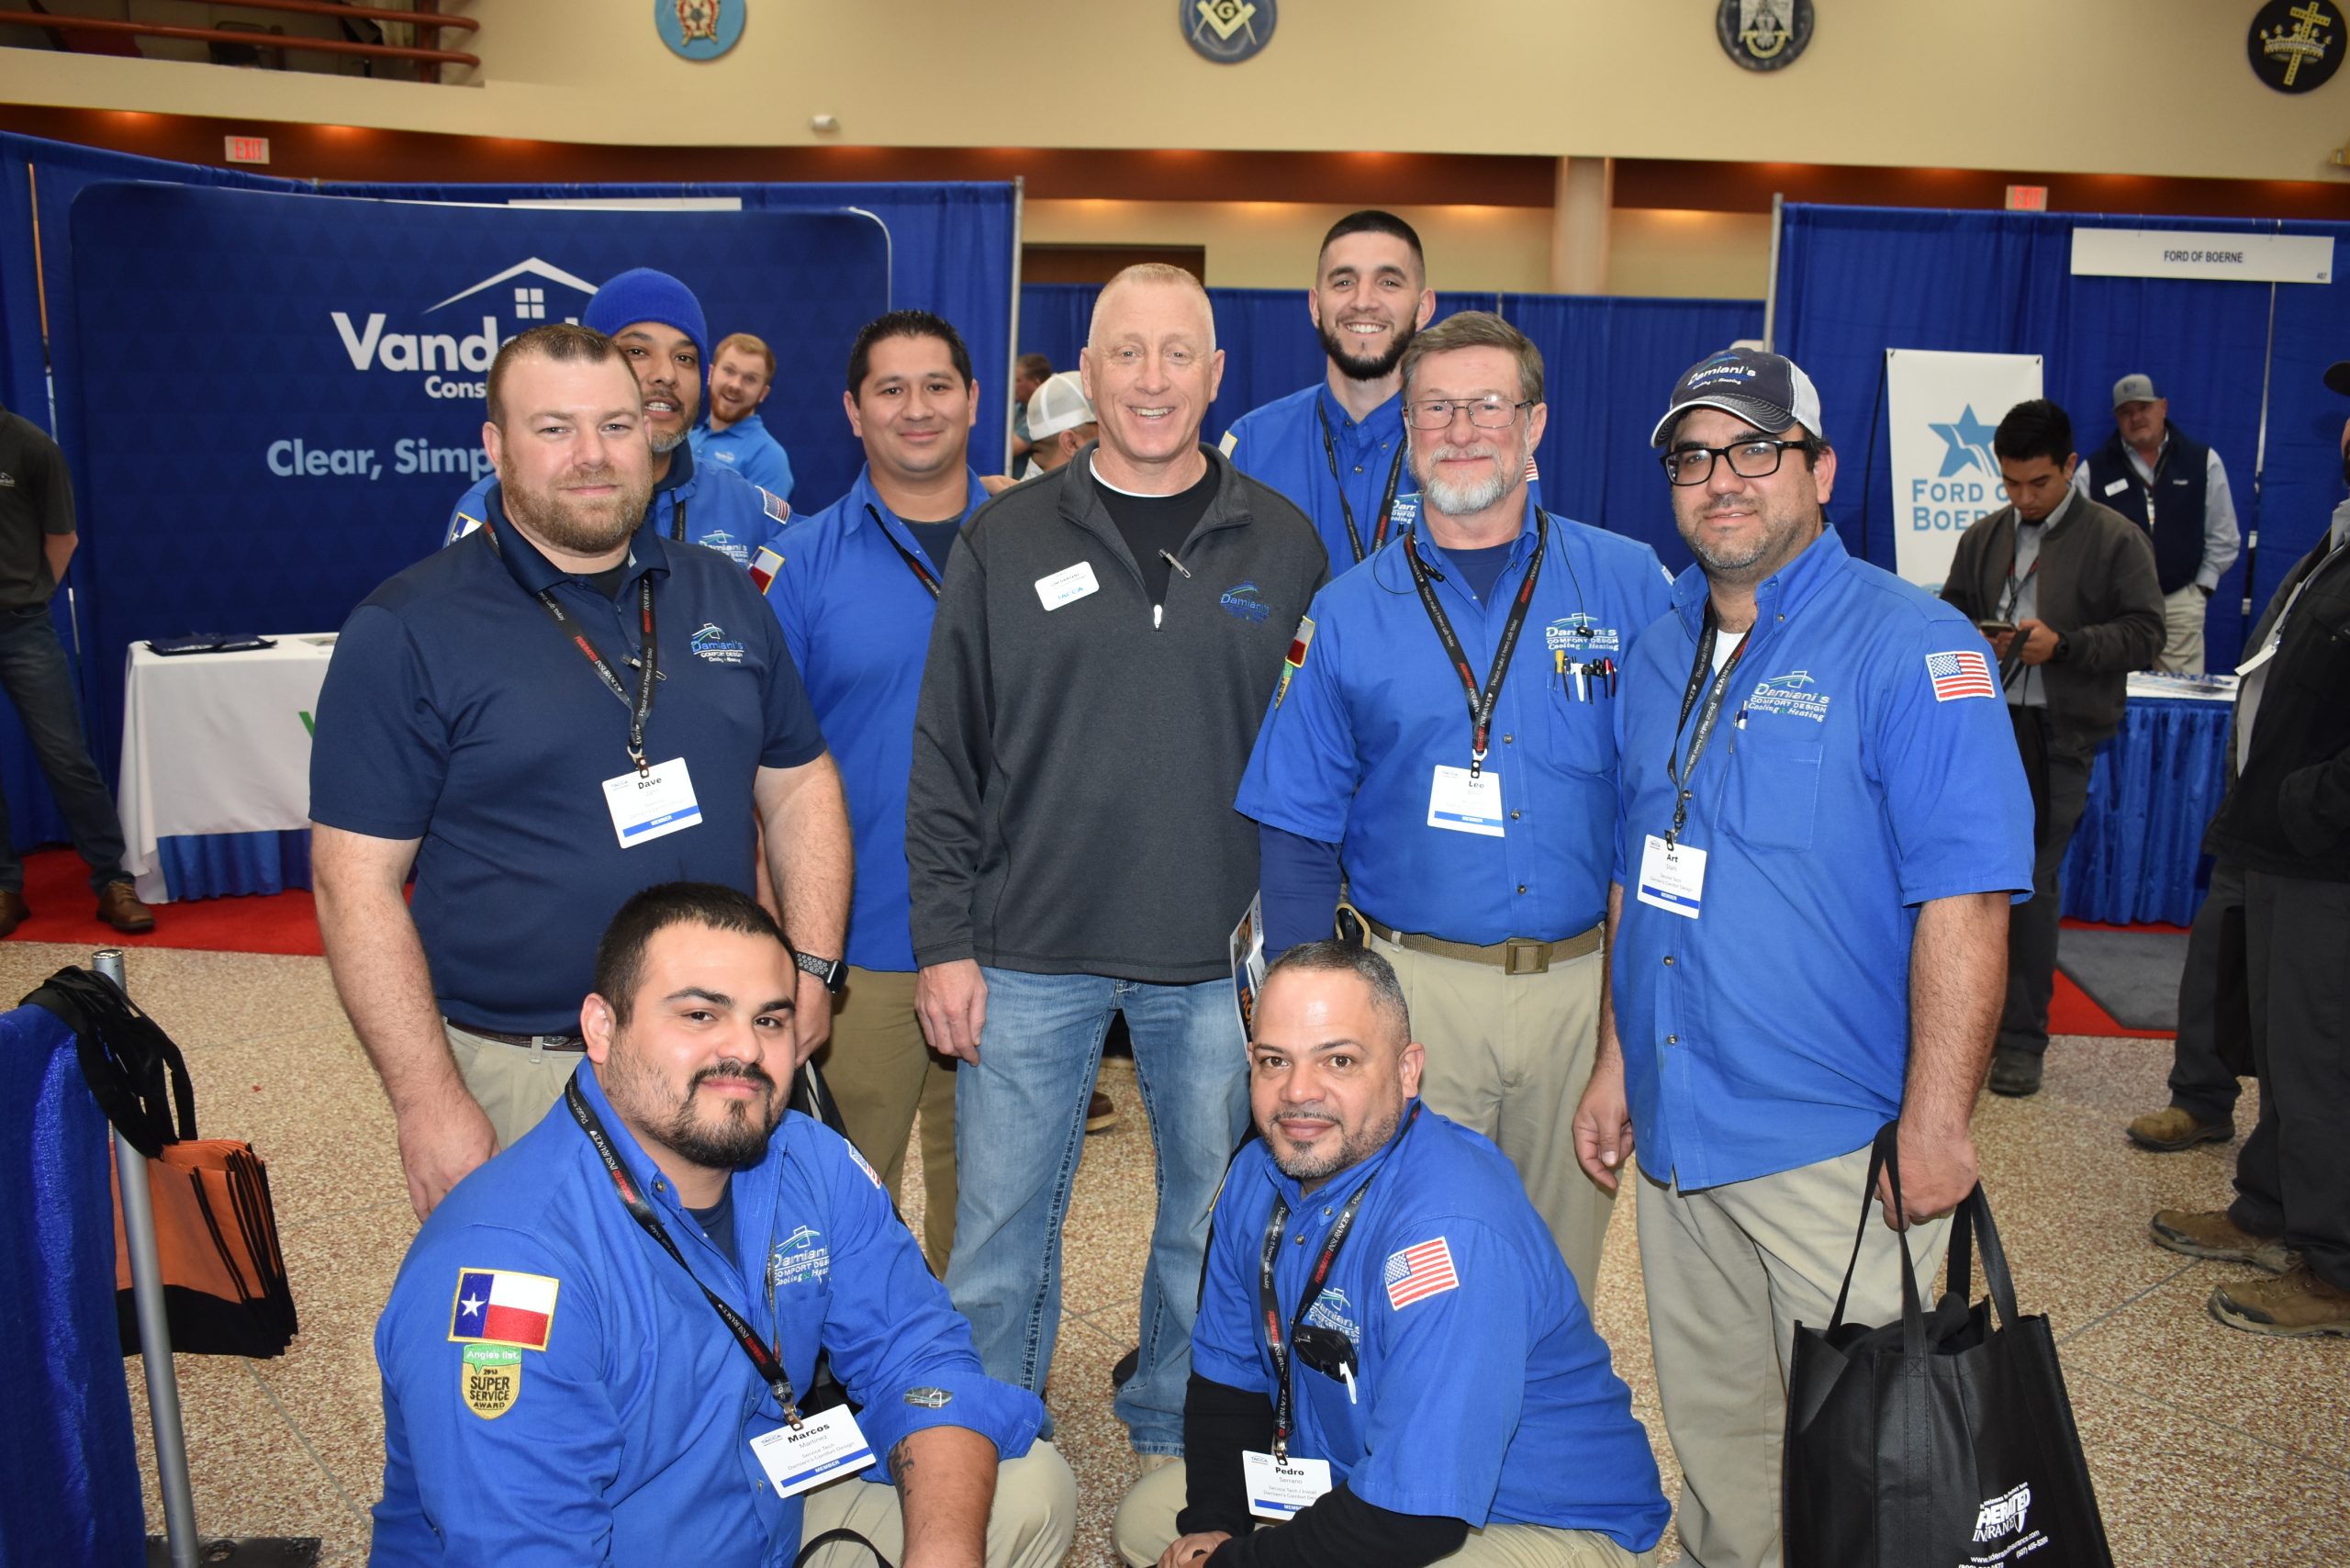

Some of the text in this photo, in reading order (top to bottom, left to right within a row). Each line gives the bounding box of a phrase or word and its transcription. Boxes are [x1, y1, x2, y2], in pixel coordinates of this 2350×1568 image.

[234, 137, 263, 162] EXIT
[2013, 185, 2042, 208] EXIT
[2164, 250, 2244, 263] FORD OF BOERNE
[330, 311, 516, 373] Vand
[266, 438, 382, 481] Clear,
[1911, 478, 1984, 503] FORD
[1548, 643, 1581, 651] Cooling
[1754, 682, 1830, 704] Damiani's
[1706, 701, 1718, 720] Please
[1748, 702, 1780, 714] Cooling
[1787, 707, 1825, 722] Heating
[1750, 696, 1827, 713] COMFORT DESIGN
[1699, 720, 1709, 734] make
[1693, 739, 1703, 755] home
[637, 778, 662, 790] Dave
[1469, 780, 1484, 789] Lee
[1666, 853, 1679, 863] Art
[593, 1134, 619, 1170] INSURANCE
[1275, 1206, 1286, 1226] Please
[1327, 1217, 1350, 1252] INSURANCE
[1265, 1245, 1275, 1262] home
[470, 1375, 510, 1390] SUPER
[469, 1390, 509, 1402] SERVICE
[788, 1423, 831, 1444] Marcos
[799, 1435, 828, 1449] Martinez
[814, 1460, 840, 1473] MEMBER
[1275, 1466, 1304, 1476] Pedro
[1279, 1476, 1304, 1484] Serrano
